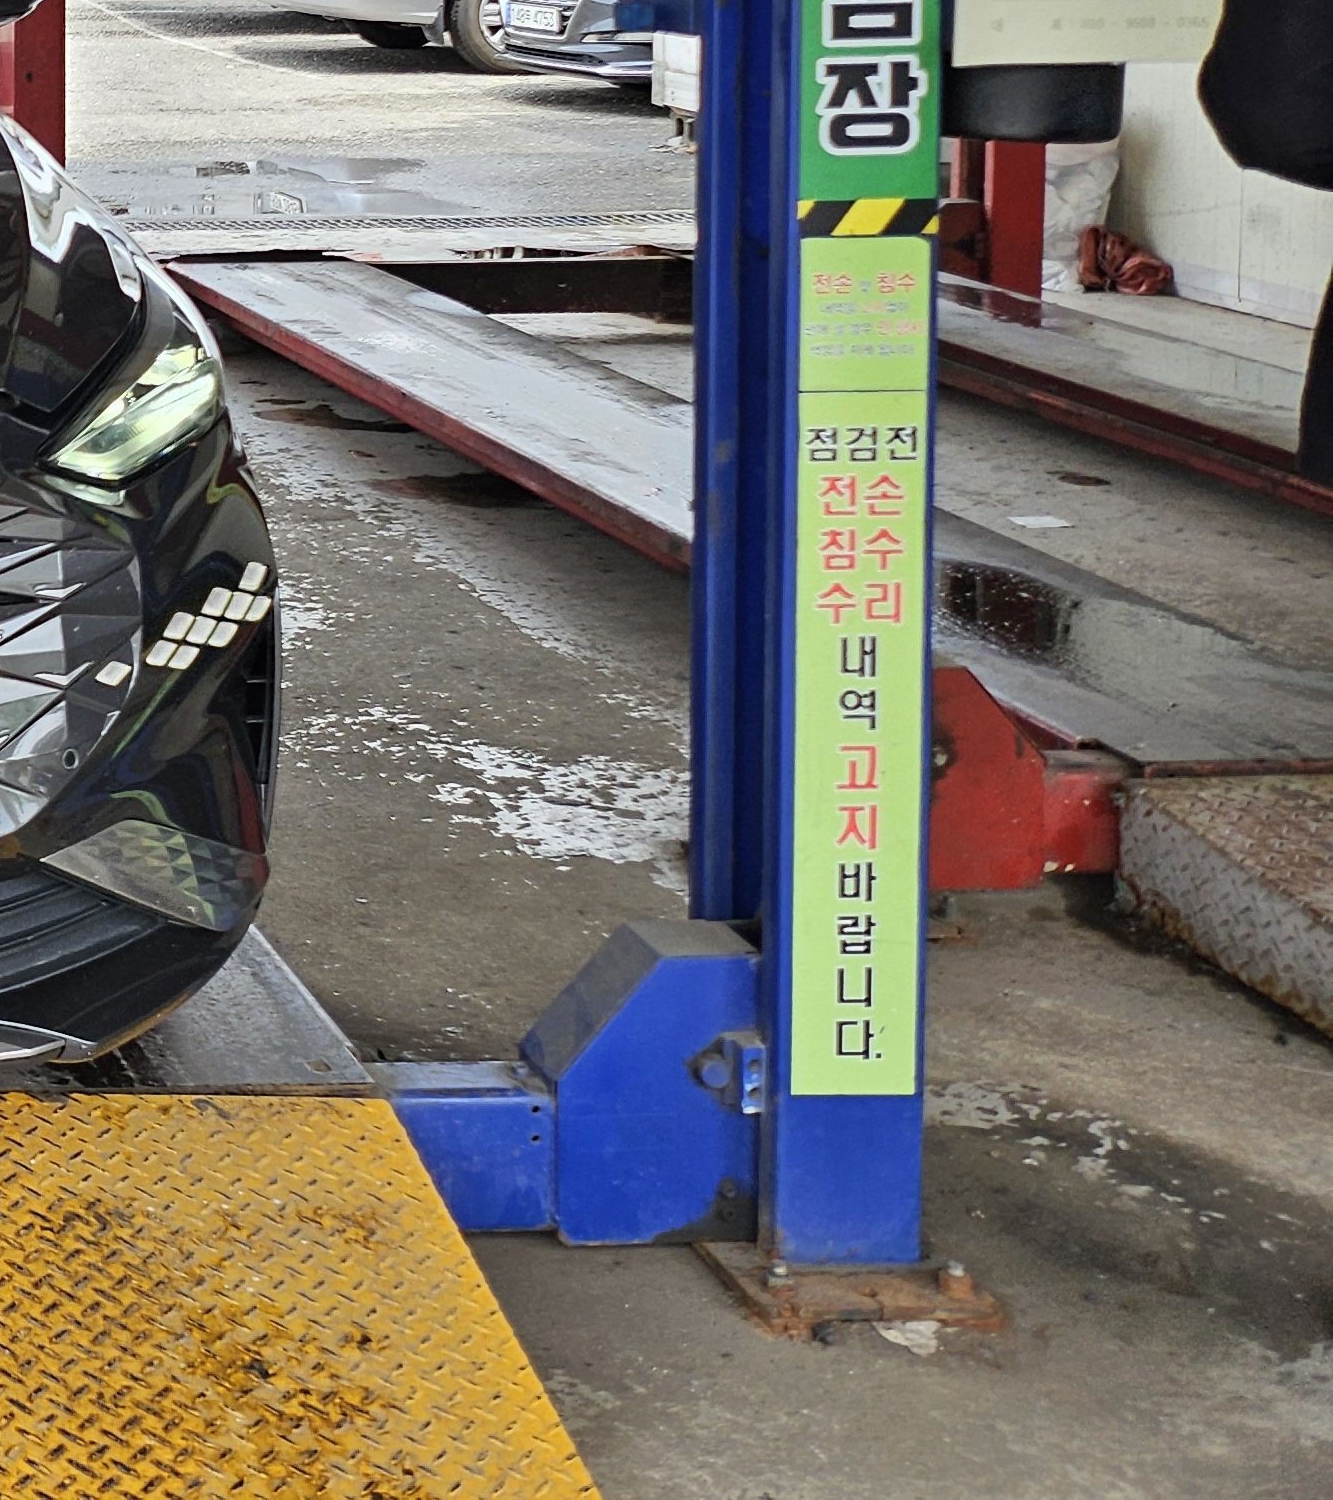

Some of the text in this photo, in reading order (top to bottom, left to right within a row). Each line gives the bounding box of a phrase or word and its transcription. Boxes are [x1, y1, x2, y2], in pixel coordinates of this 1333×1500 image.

[805, 426, 918, 462] 점검전
[819, 474, 903, 516] 전손
[819, 529, 903, 571] 침수
[816, 582, 902, 624] 수리
